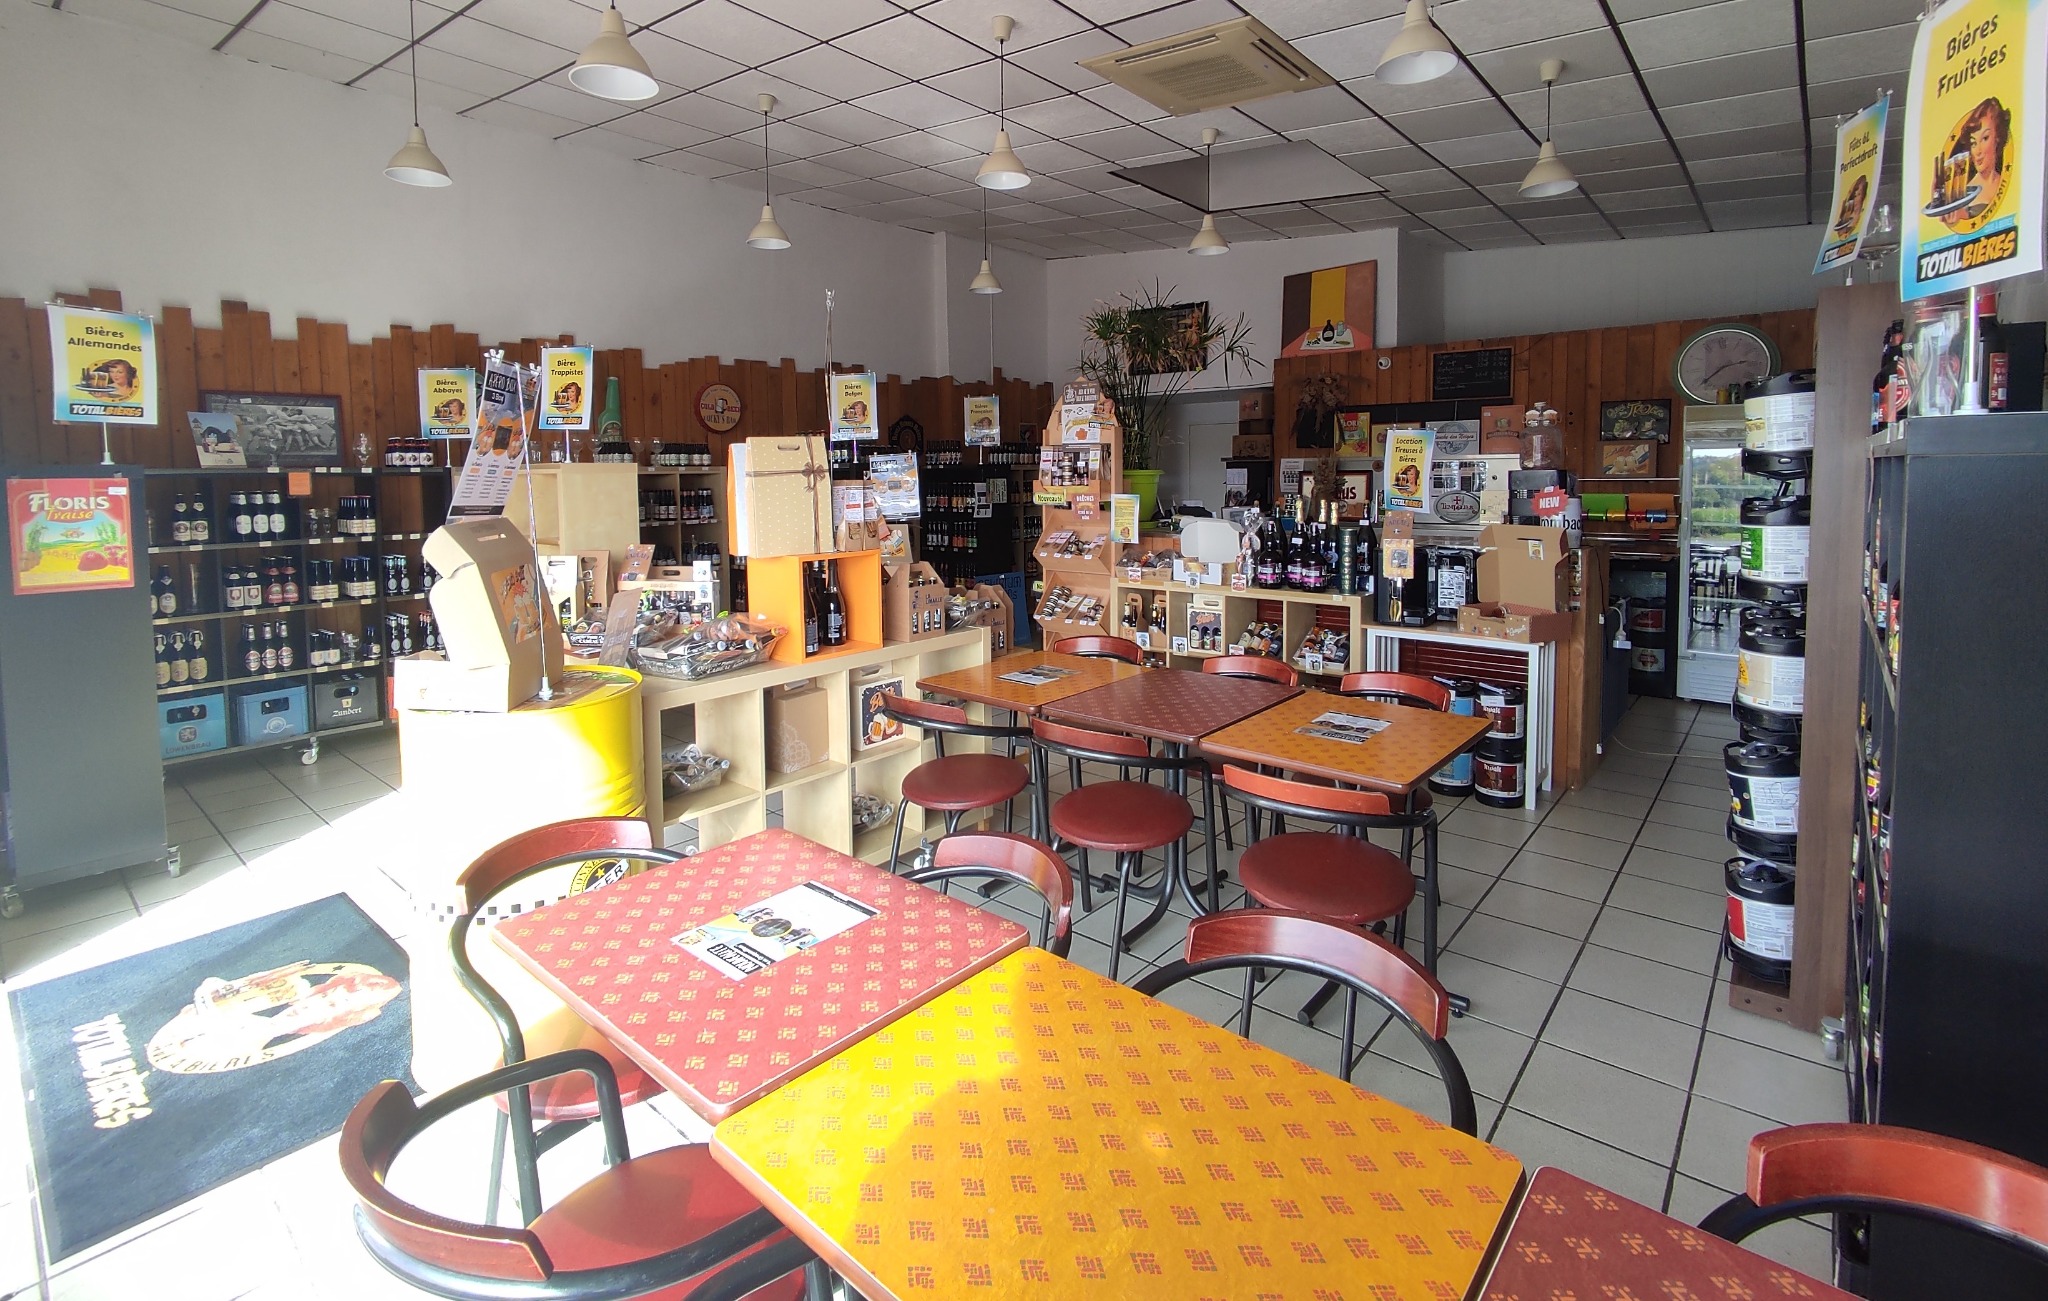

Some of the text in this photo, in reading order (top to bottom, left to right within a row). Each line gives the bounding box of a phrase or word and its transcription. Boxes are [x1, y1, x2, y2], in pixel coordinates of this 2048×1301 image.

[1946, 12, 1999, 62] Bières
[1937, 43, 2008, 99] Fruitées
[1848, 136, 1862, 153] Fûts
[1840, 143, 1878, 174] Perfectdraft
[85, 326, 125, 338] Bières
[68, 337, 142, 352] Allemandes
[557, 359, 576, 367] Bières
[551, 369, 584, 377] Trappistes
[1399, 455, 1417, 463] Bières
[28, 493, 111, 513] FLORIS
[1037, 494, 1062, 502] Nouveauté
[1539, 496, 1560, 508] NEW
[1741, 540, 1752, 560] IPA
[331, 706, 362, 717] Zundert
